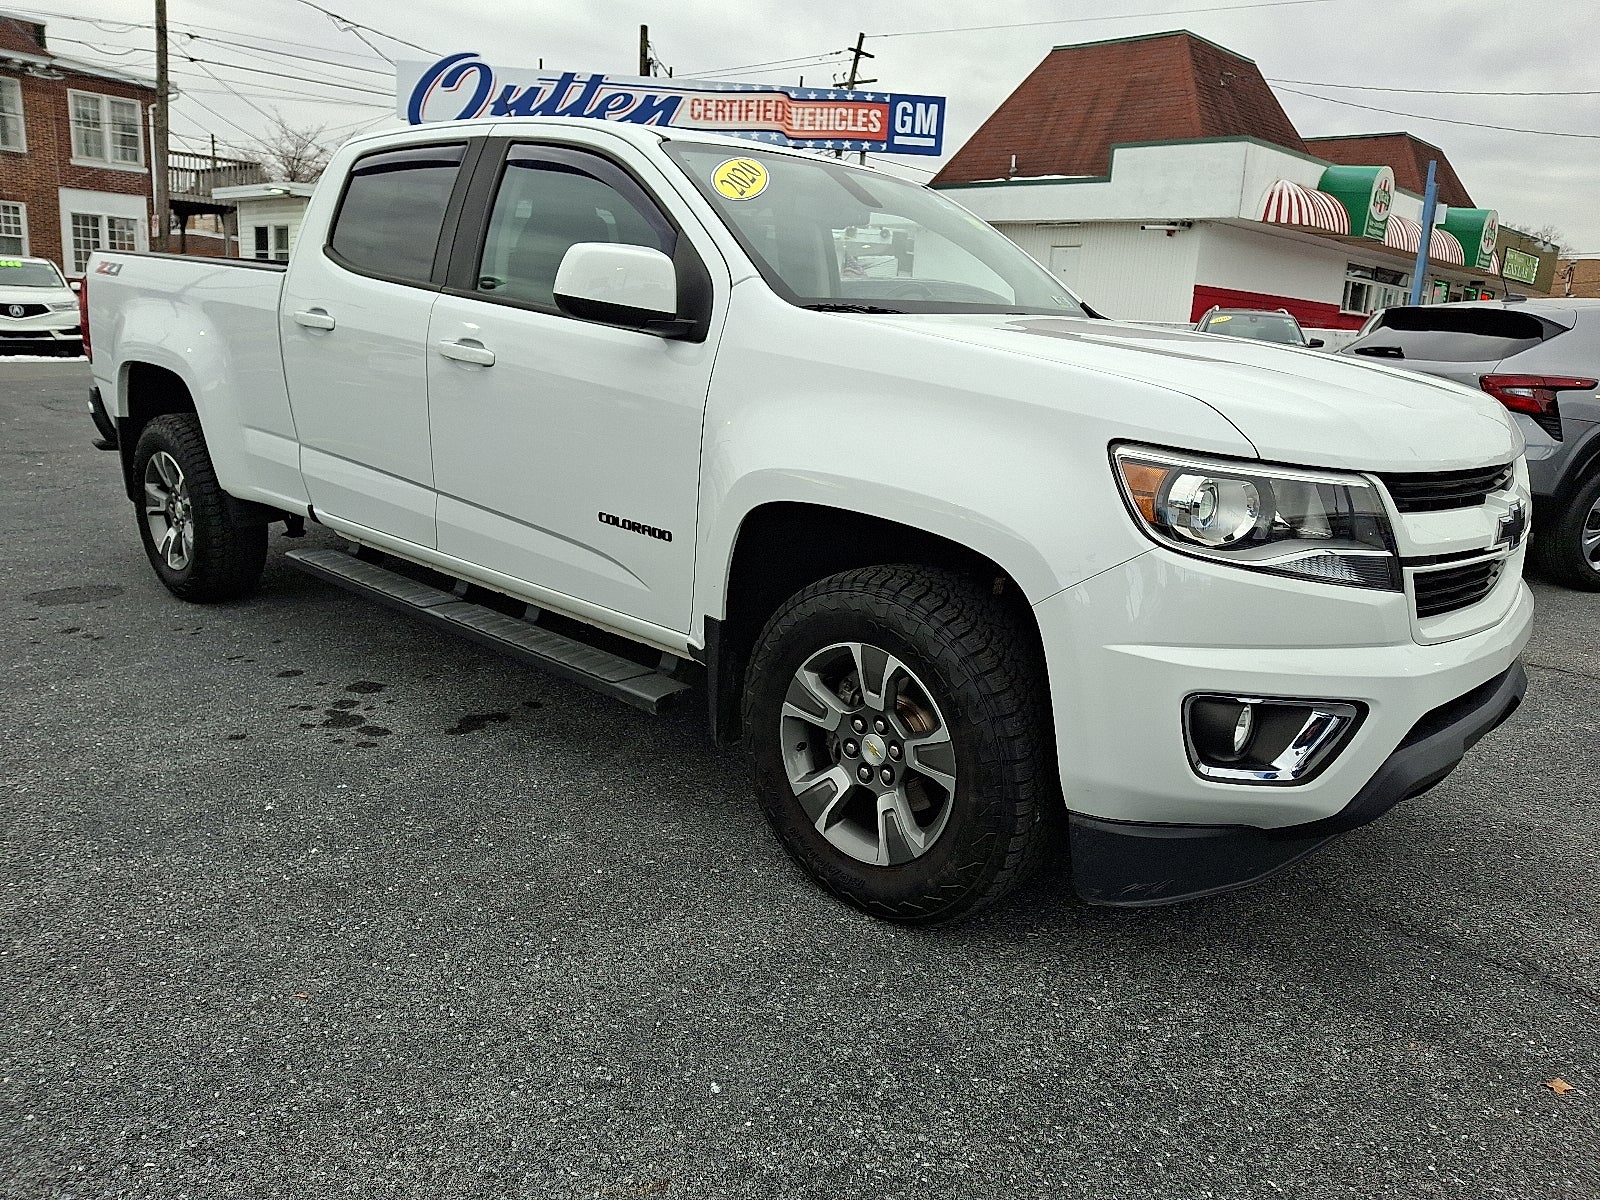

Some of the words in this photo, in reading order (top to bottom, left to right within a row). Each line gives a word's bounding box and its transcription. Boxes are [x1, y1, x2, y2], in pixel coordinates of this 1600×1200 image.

[407, 53, 684, 127] Outten
[690, 98, 785, 123] CERTIFIED
[790, 105, 882, 132] VEHICLES
[894, 101, 939, 136] GM
[720, 160, 762, 197] 2020
[95, 260, 124, 276] Z71
[598, 511, 673, 542] COLORADO
